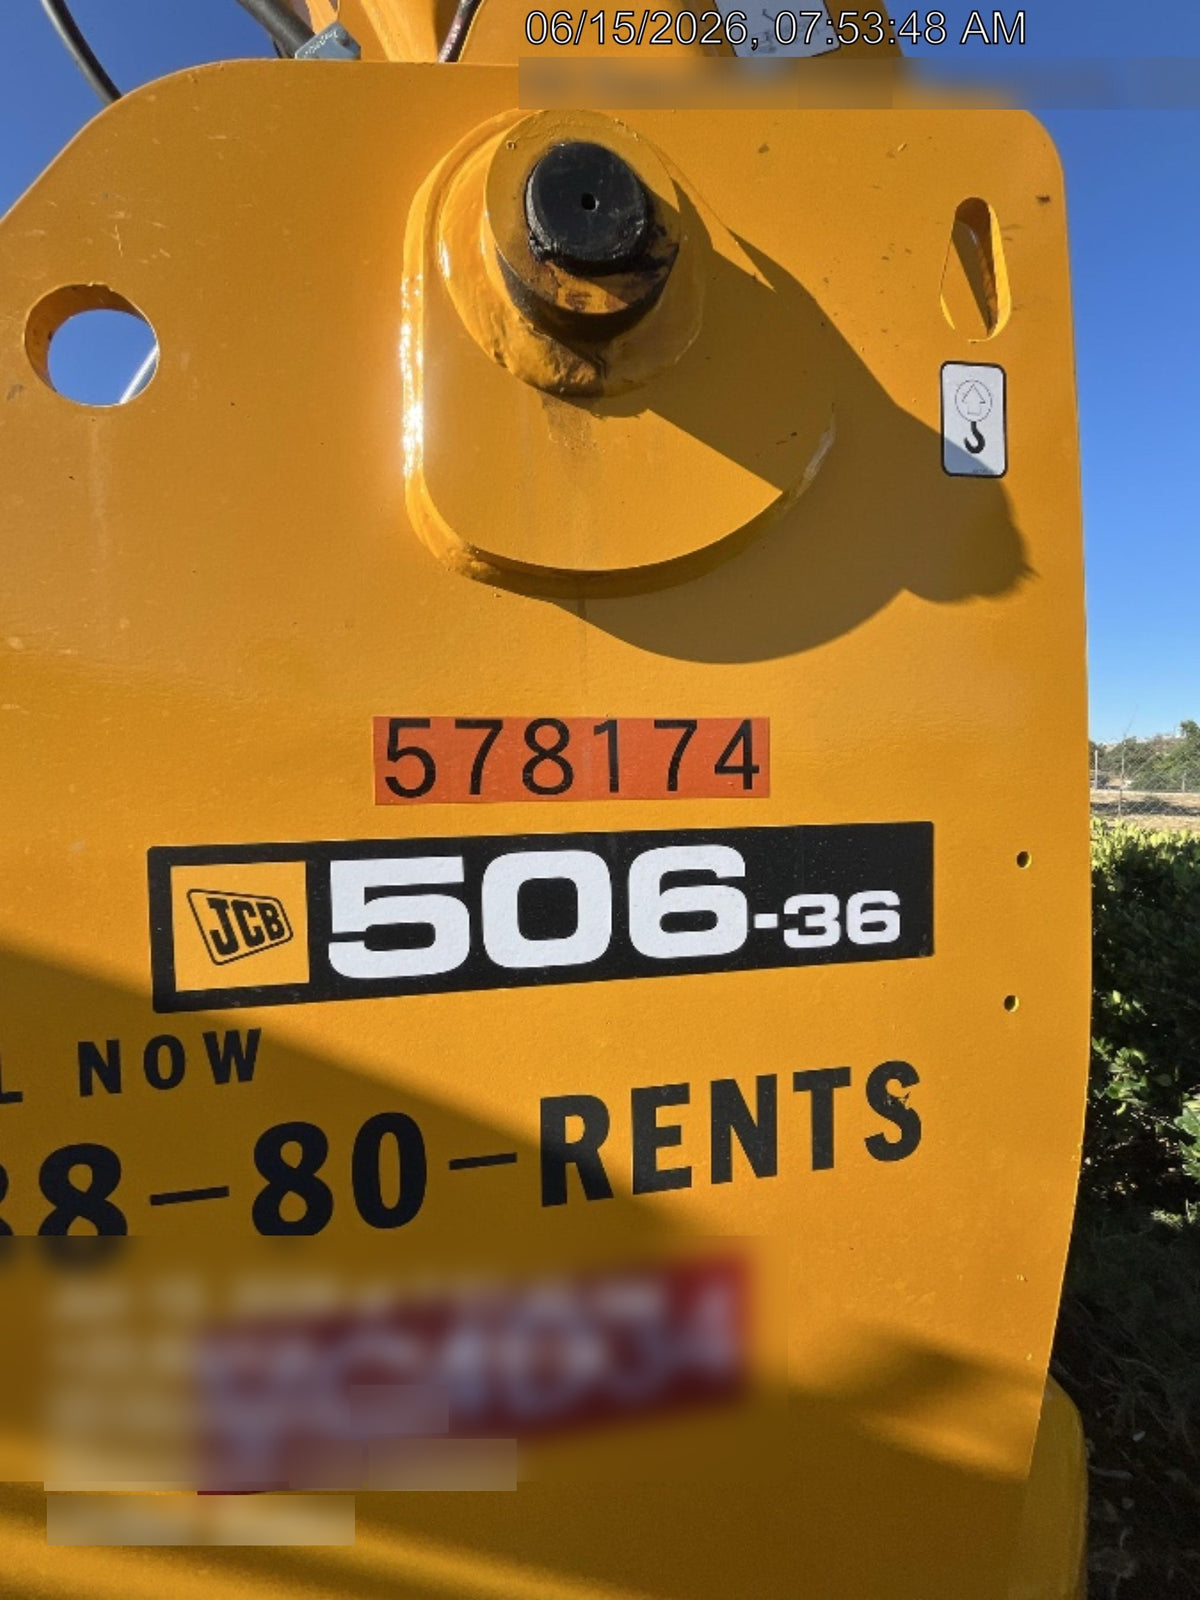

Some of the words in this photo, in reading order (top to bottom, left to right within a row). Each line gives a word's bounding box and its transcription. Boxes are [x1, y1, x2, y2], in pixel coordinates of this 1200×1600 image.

[384, 717, 760, 798] 578174
[206, 897, 285, 956] JCB
[328, 844, 901, 980] 506-36
[77, 1027, 262, 1098] NOW
